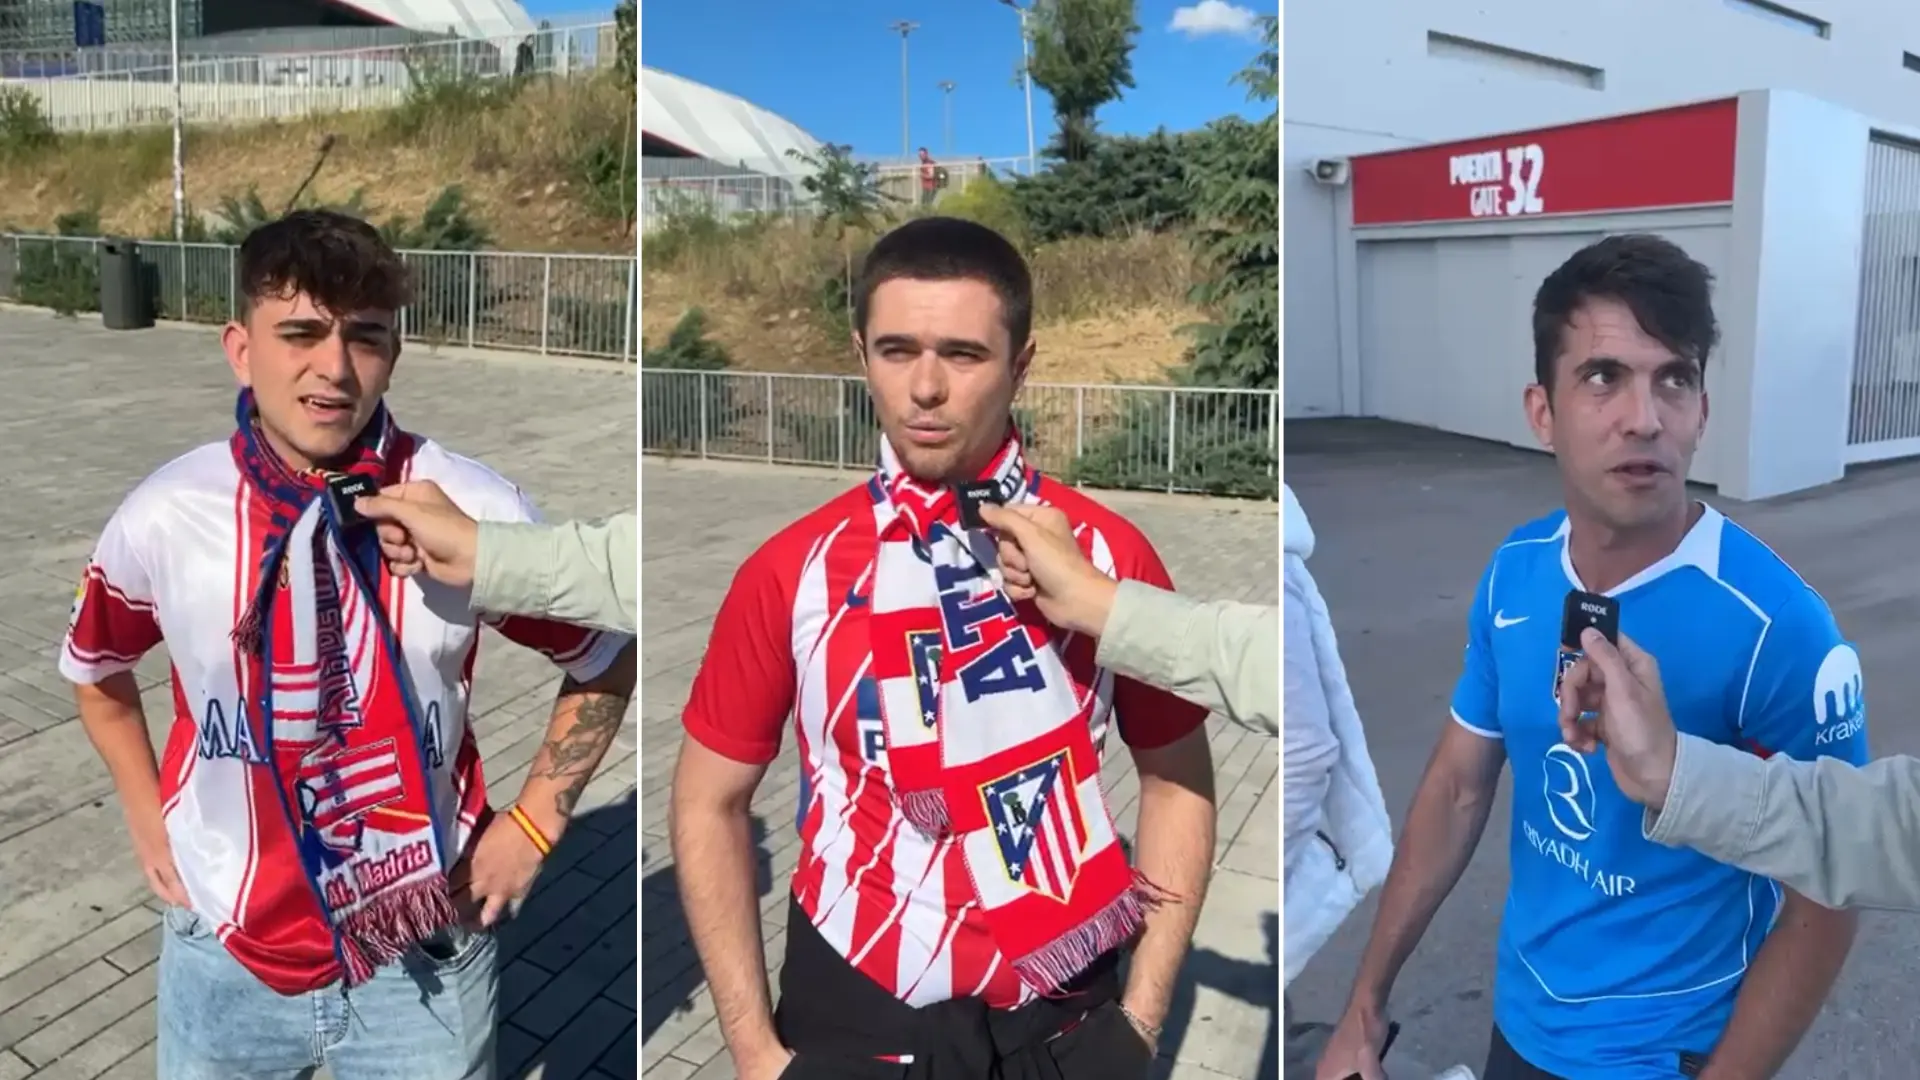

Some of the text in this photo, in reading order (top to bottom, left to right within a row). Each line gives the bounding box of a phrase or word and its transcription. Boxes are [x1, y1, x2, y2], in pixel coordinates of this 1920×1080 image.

[1449, 151, 1502, 185] PUERTA
[1506, 143, 1544, 216] 32
[1470, 185, 1503, 217] GATE
[354, 840, 433, 897] Madrid
[1523, 820, 1636, 897] RIYADH AIR
